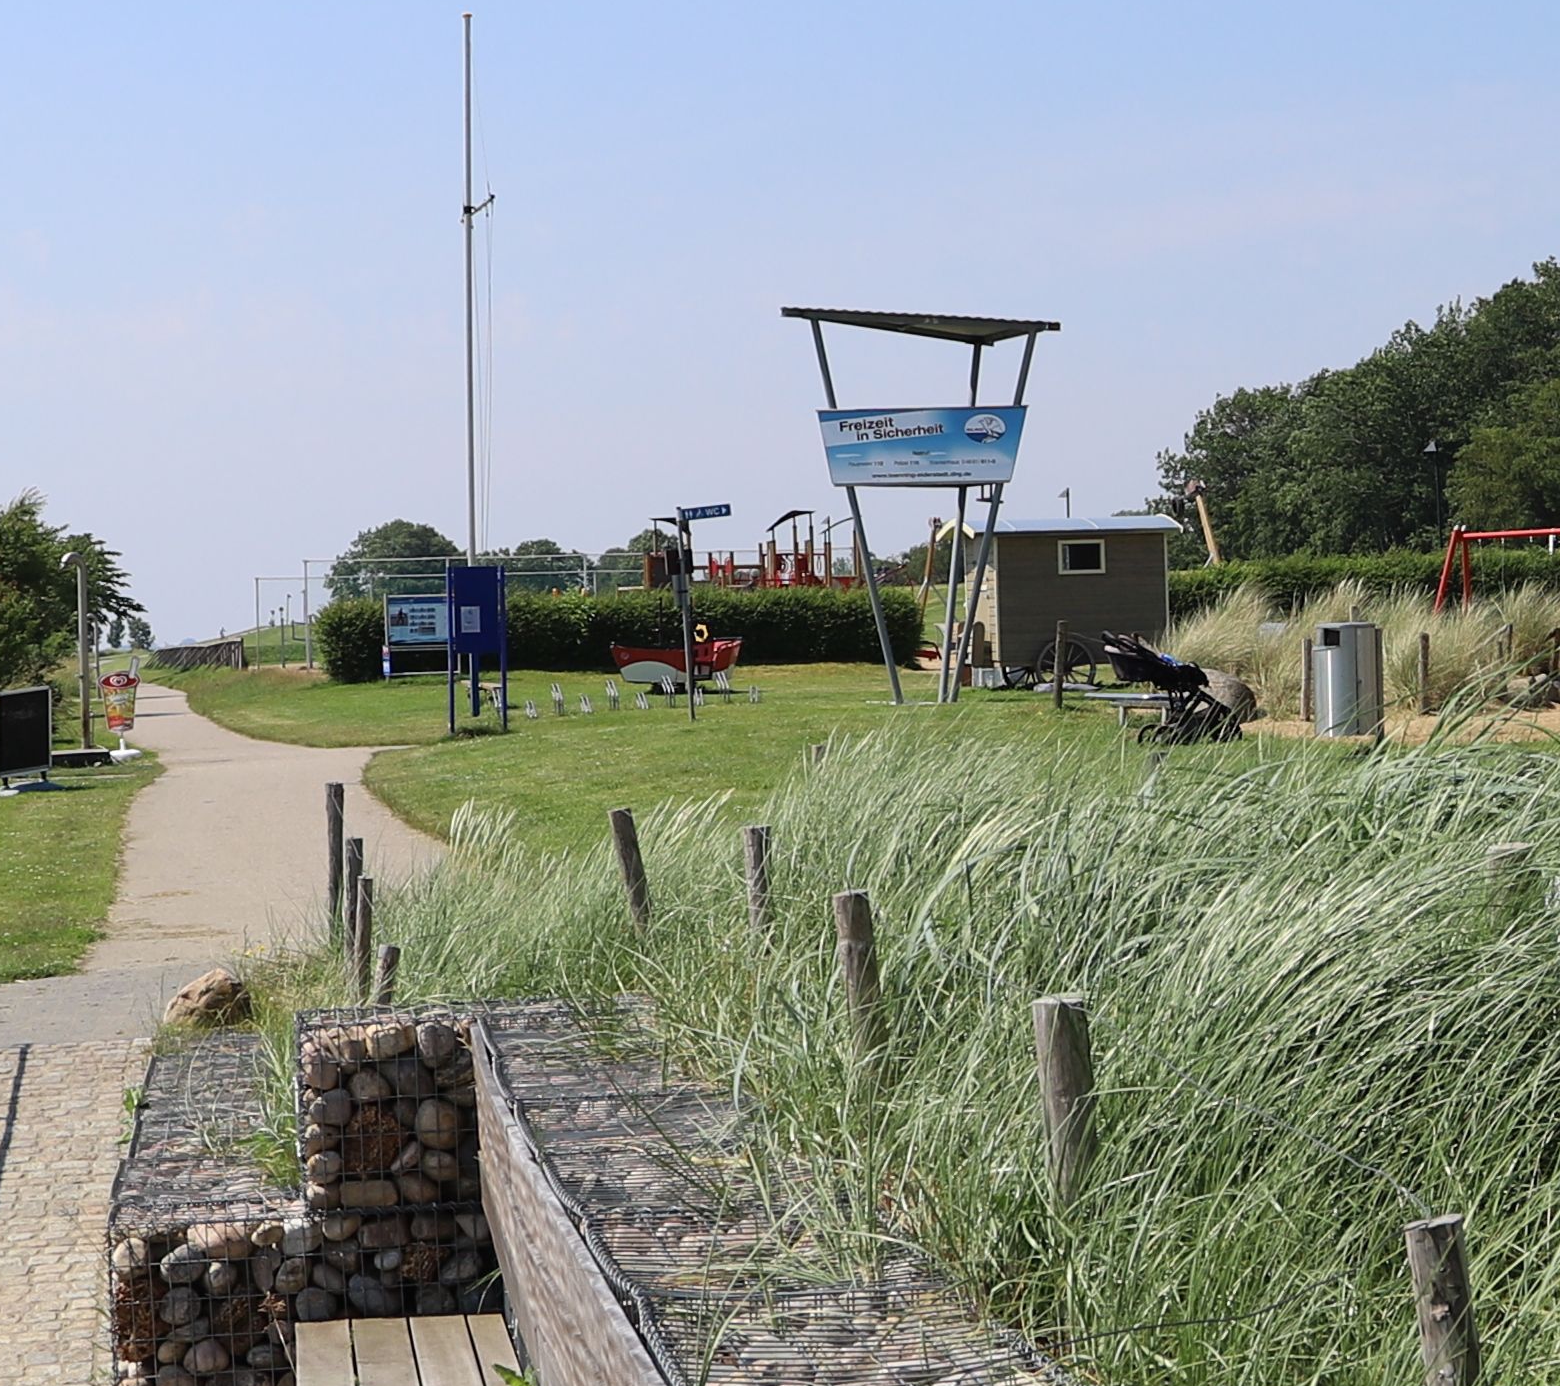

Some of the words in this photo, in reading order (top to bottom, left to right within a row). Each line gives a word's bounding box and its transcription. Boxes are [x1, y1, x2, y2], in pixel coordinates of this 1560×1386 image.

[839, 417, 894, 432] Freizeit
[856, 430, 870, 441] in
[873, 424, 944, 440] Sicherheit
[705, 507, 720, 516] WC
